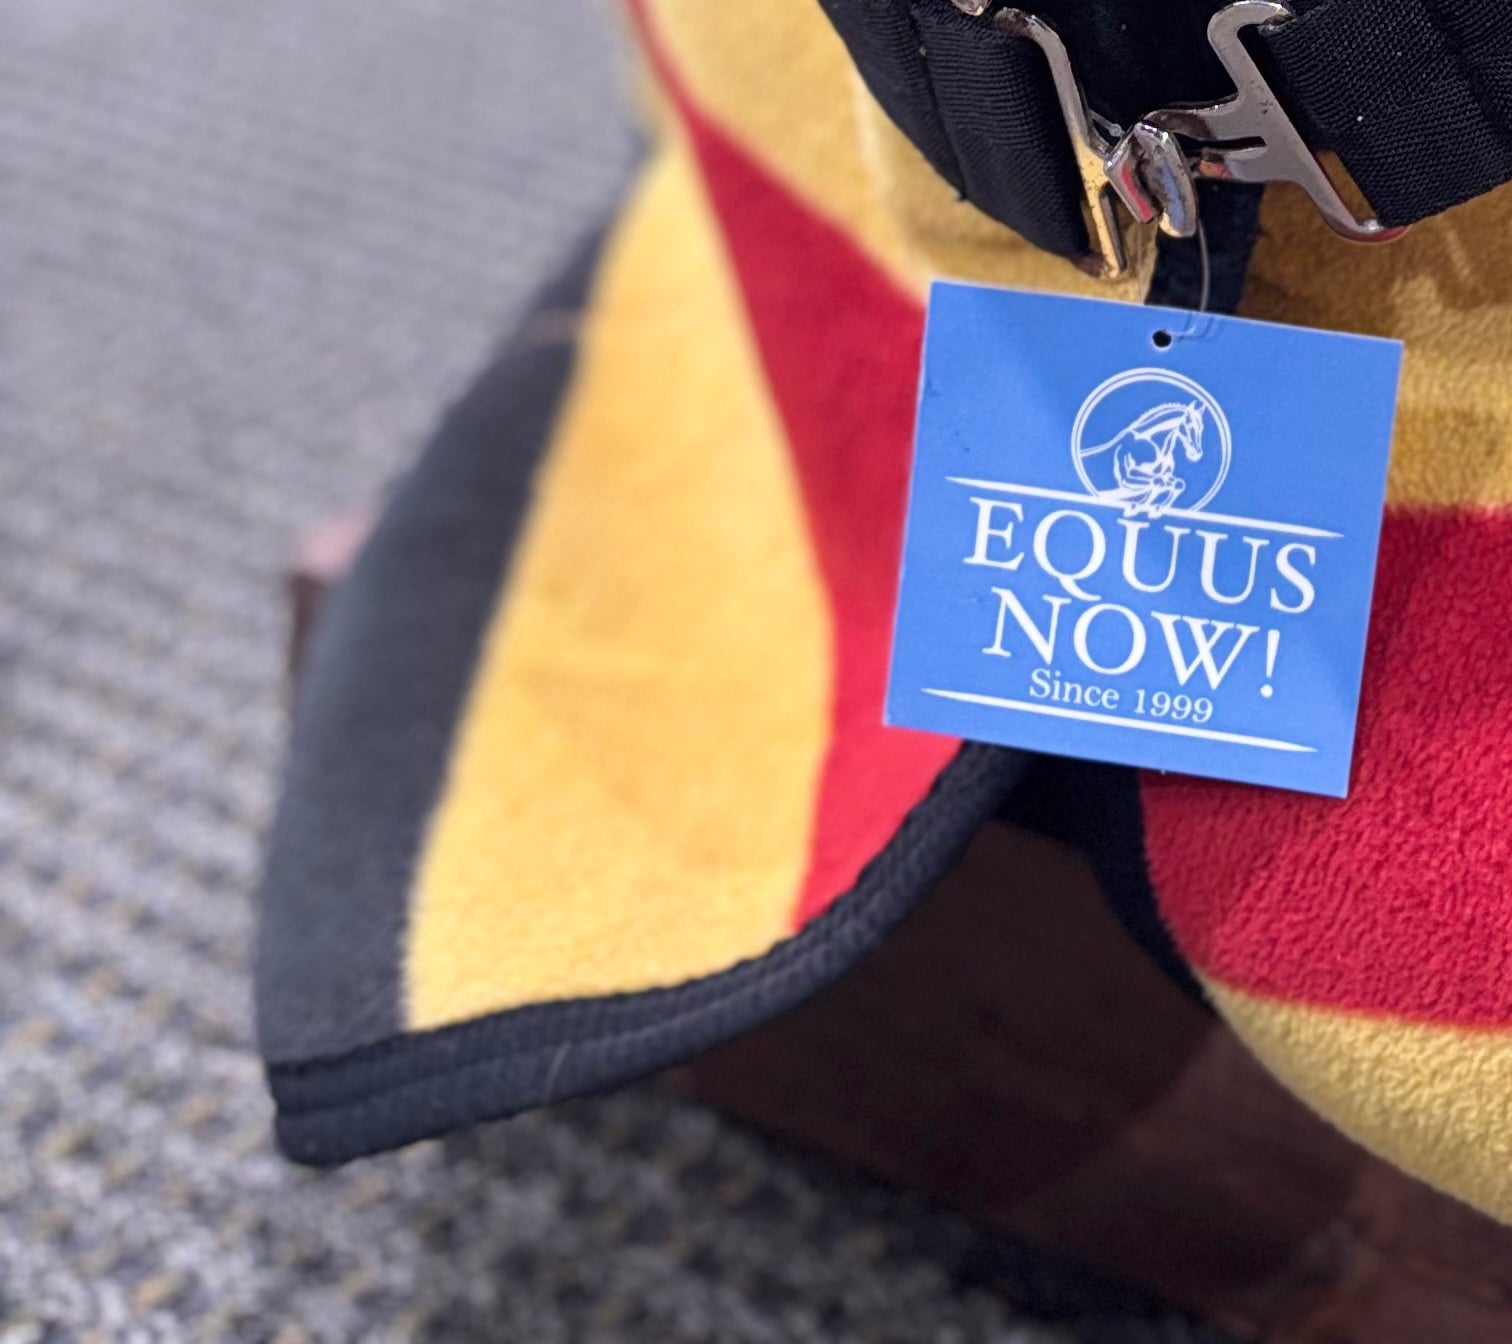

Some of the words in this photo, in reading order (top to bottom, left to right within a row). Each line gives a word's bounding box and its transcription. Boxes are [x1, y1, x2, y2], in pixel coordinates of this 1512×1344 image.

[963, 496, 1317, 614] EQUUS
[982, 586, 1281, 699] NOW!
[1028, 668, 1121, 710] Since
[1133, 688, 1214, 724] 1999
